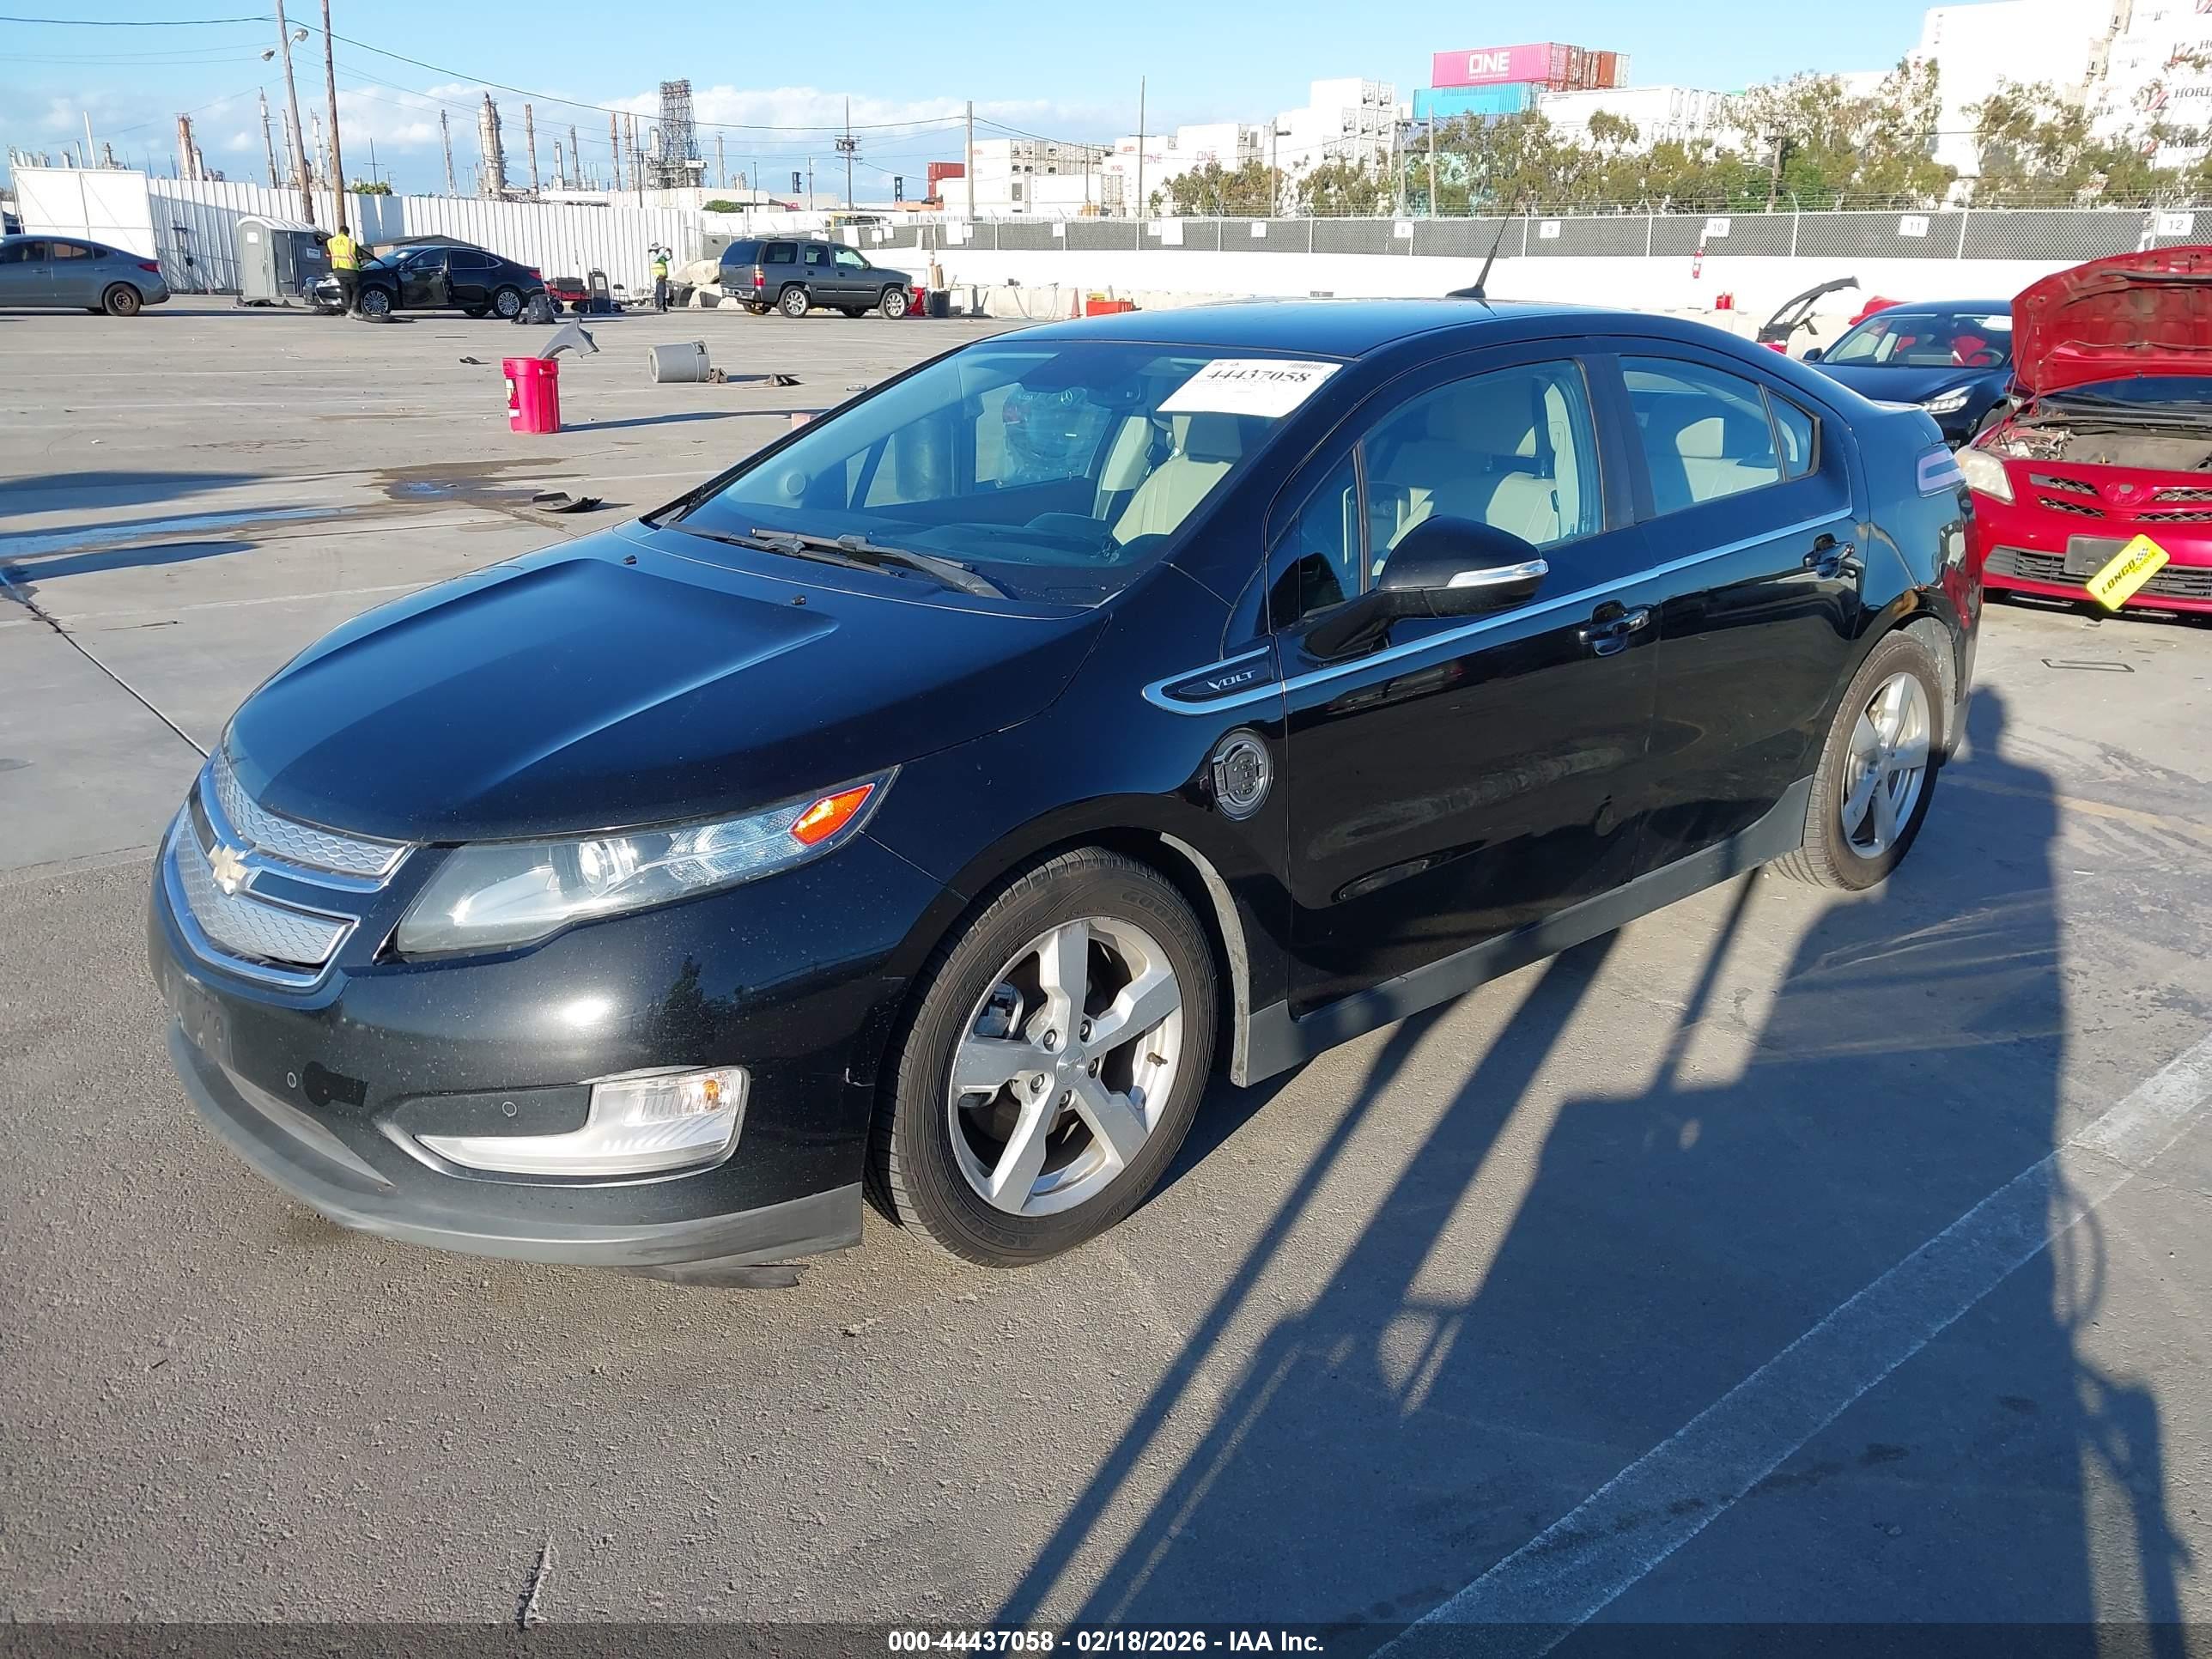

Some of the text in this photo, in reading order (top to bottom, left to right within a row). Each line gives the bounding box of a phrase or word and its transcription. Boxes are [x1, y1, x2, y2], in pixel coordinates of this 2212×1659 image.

[1469, 52, 1510, 74] ONE
[2174, 87, 2212, 99] HORI
[1143, 153, 1163, 165] ONE
[1196, 150, 1217, 162] ONE
[1713, 222, 1723, 232] 10
[1910, 221, 1920, 232] 11
[2169, 219, 2184, 230] 12
[1206, 368, 1312, 383] 44437058
[2132, 550, 2157, 574] TOYOTA
[2101, 559, 2136, 595] LONGO
[1207, 670, 1257, 690] VOLT
